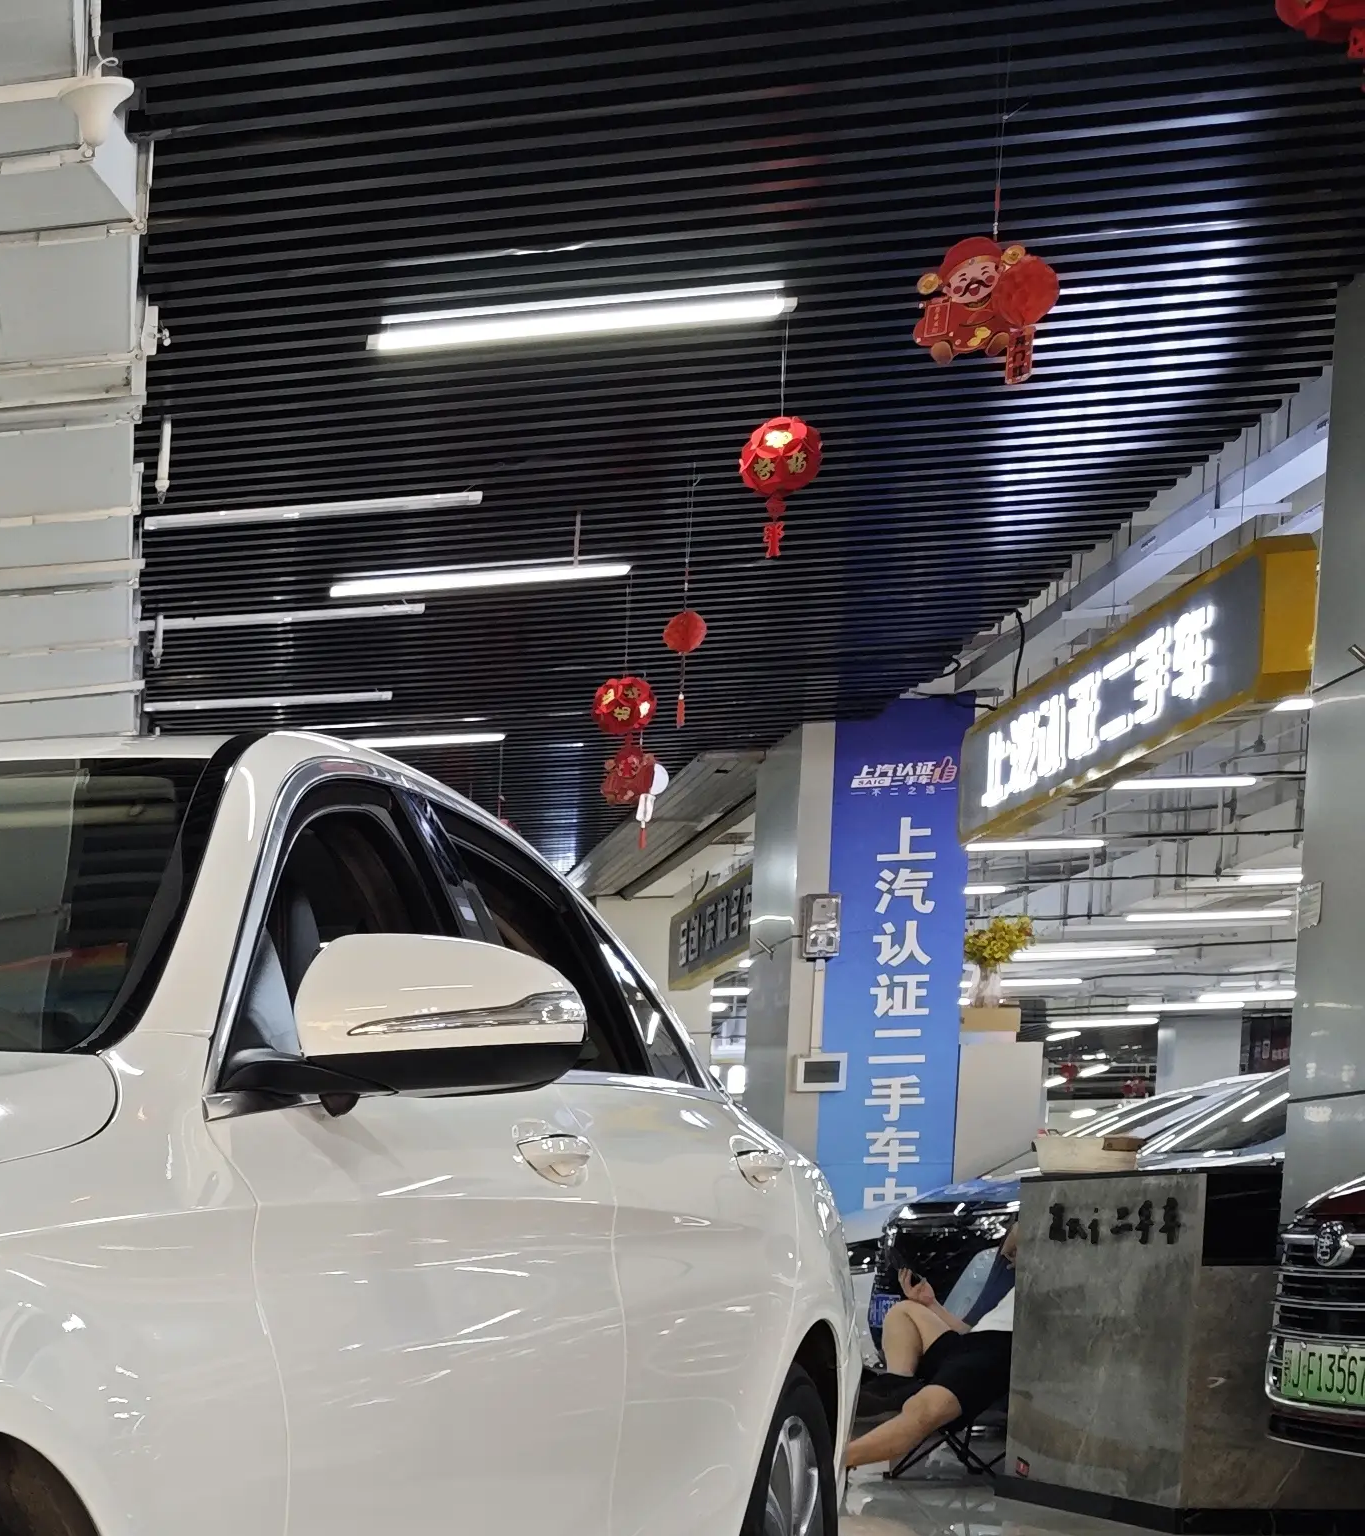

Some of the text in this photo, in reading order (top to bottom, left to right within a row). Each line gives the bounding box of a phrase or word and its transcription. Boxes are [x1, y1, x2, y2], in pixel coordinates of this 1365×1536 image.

[854, 761, 937, 779] 上汽认证
[857, 778, 887, 787] SAIC
